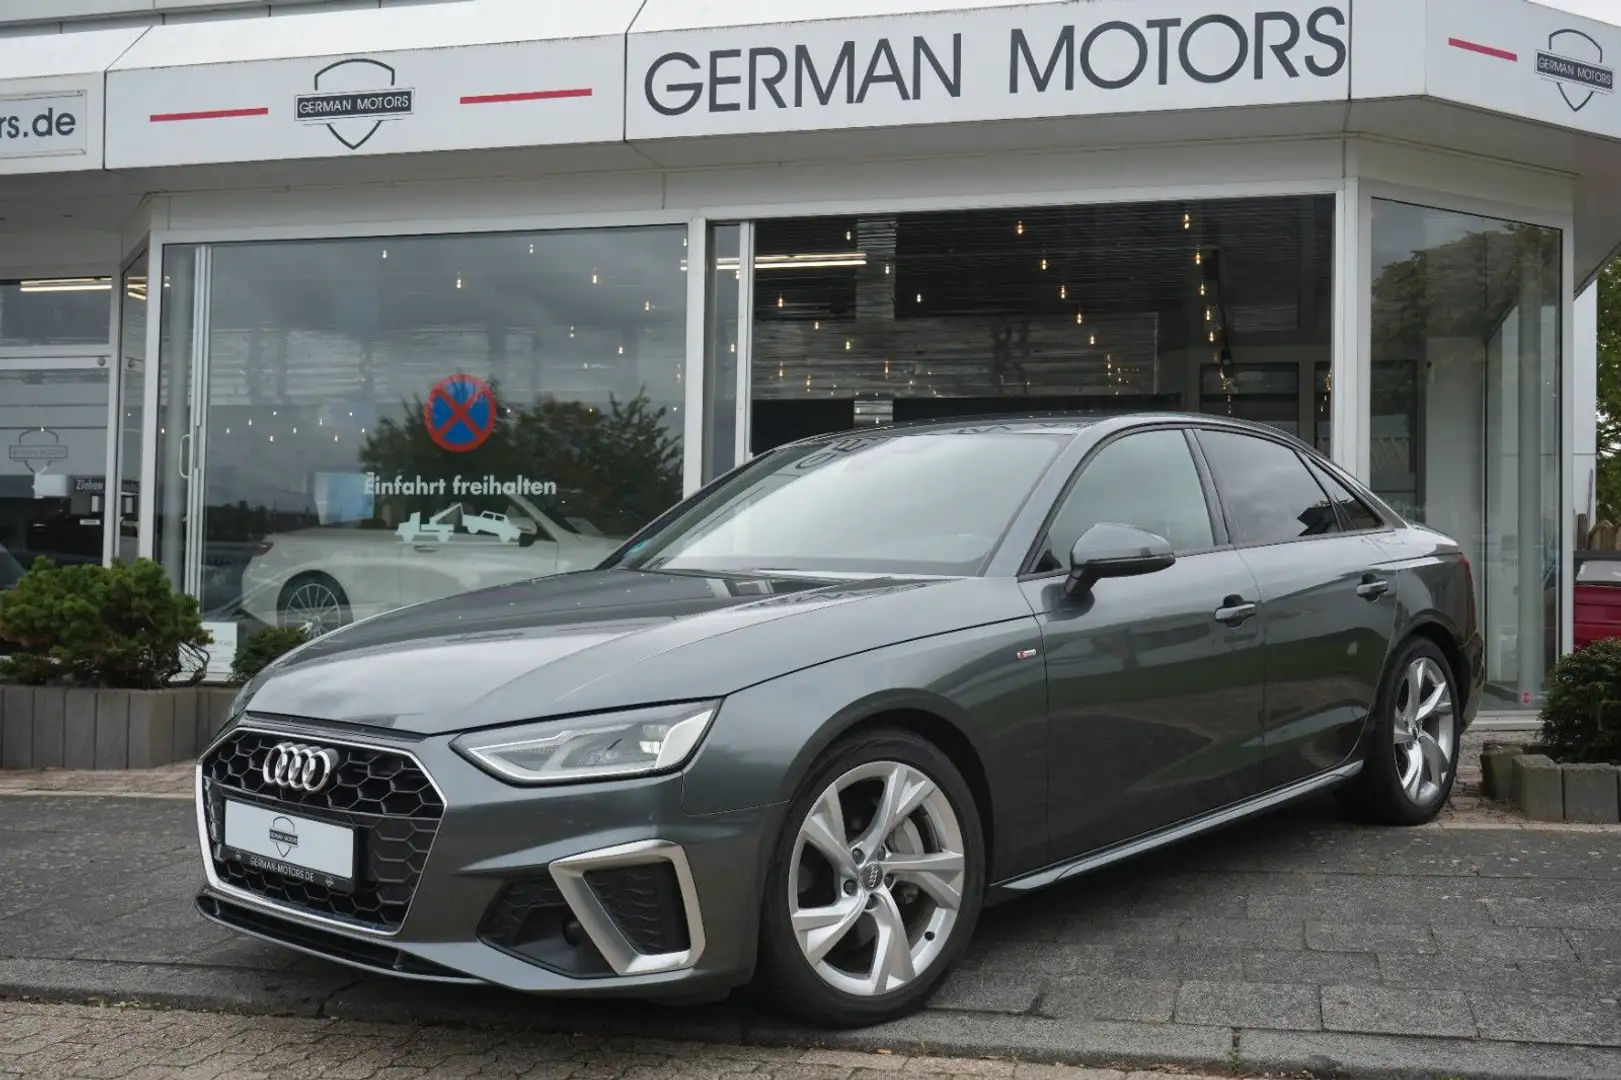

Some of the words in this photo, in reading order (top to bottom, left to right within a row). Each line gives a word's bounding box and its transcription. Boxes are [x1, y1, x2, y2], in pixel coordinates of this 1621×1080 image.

[644, 33, 961, 116] GERMAN
[1009, 6, 1346, 93] MOTORS
[1538, 57, 1574, 75] GERMAN
[1577, 67, 1611, 85] MOTORS
[300, 98, 351, 113] GERMAN
[357, 95, 409, 110] MOTORS
[364, 472, 446, 495] Einfahrt
[452, 474, 557, 495] freihalten
